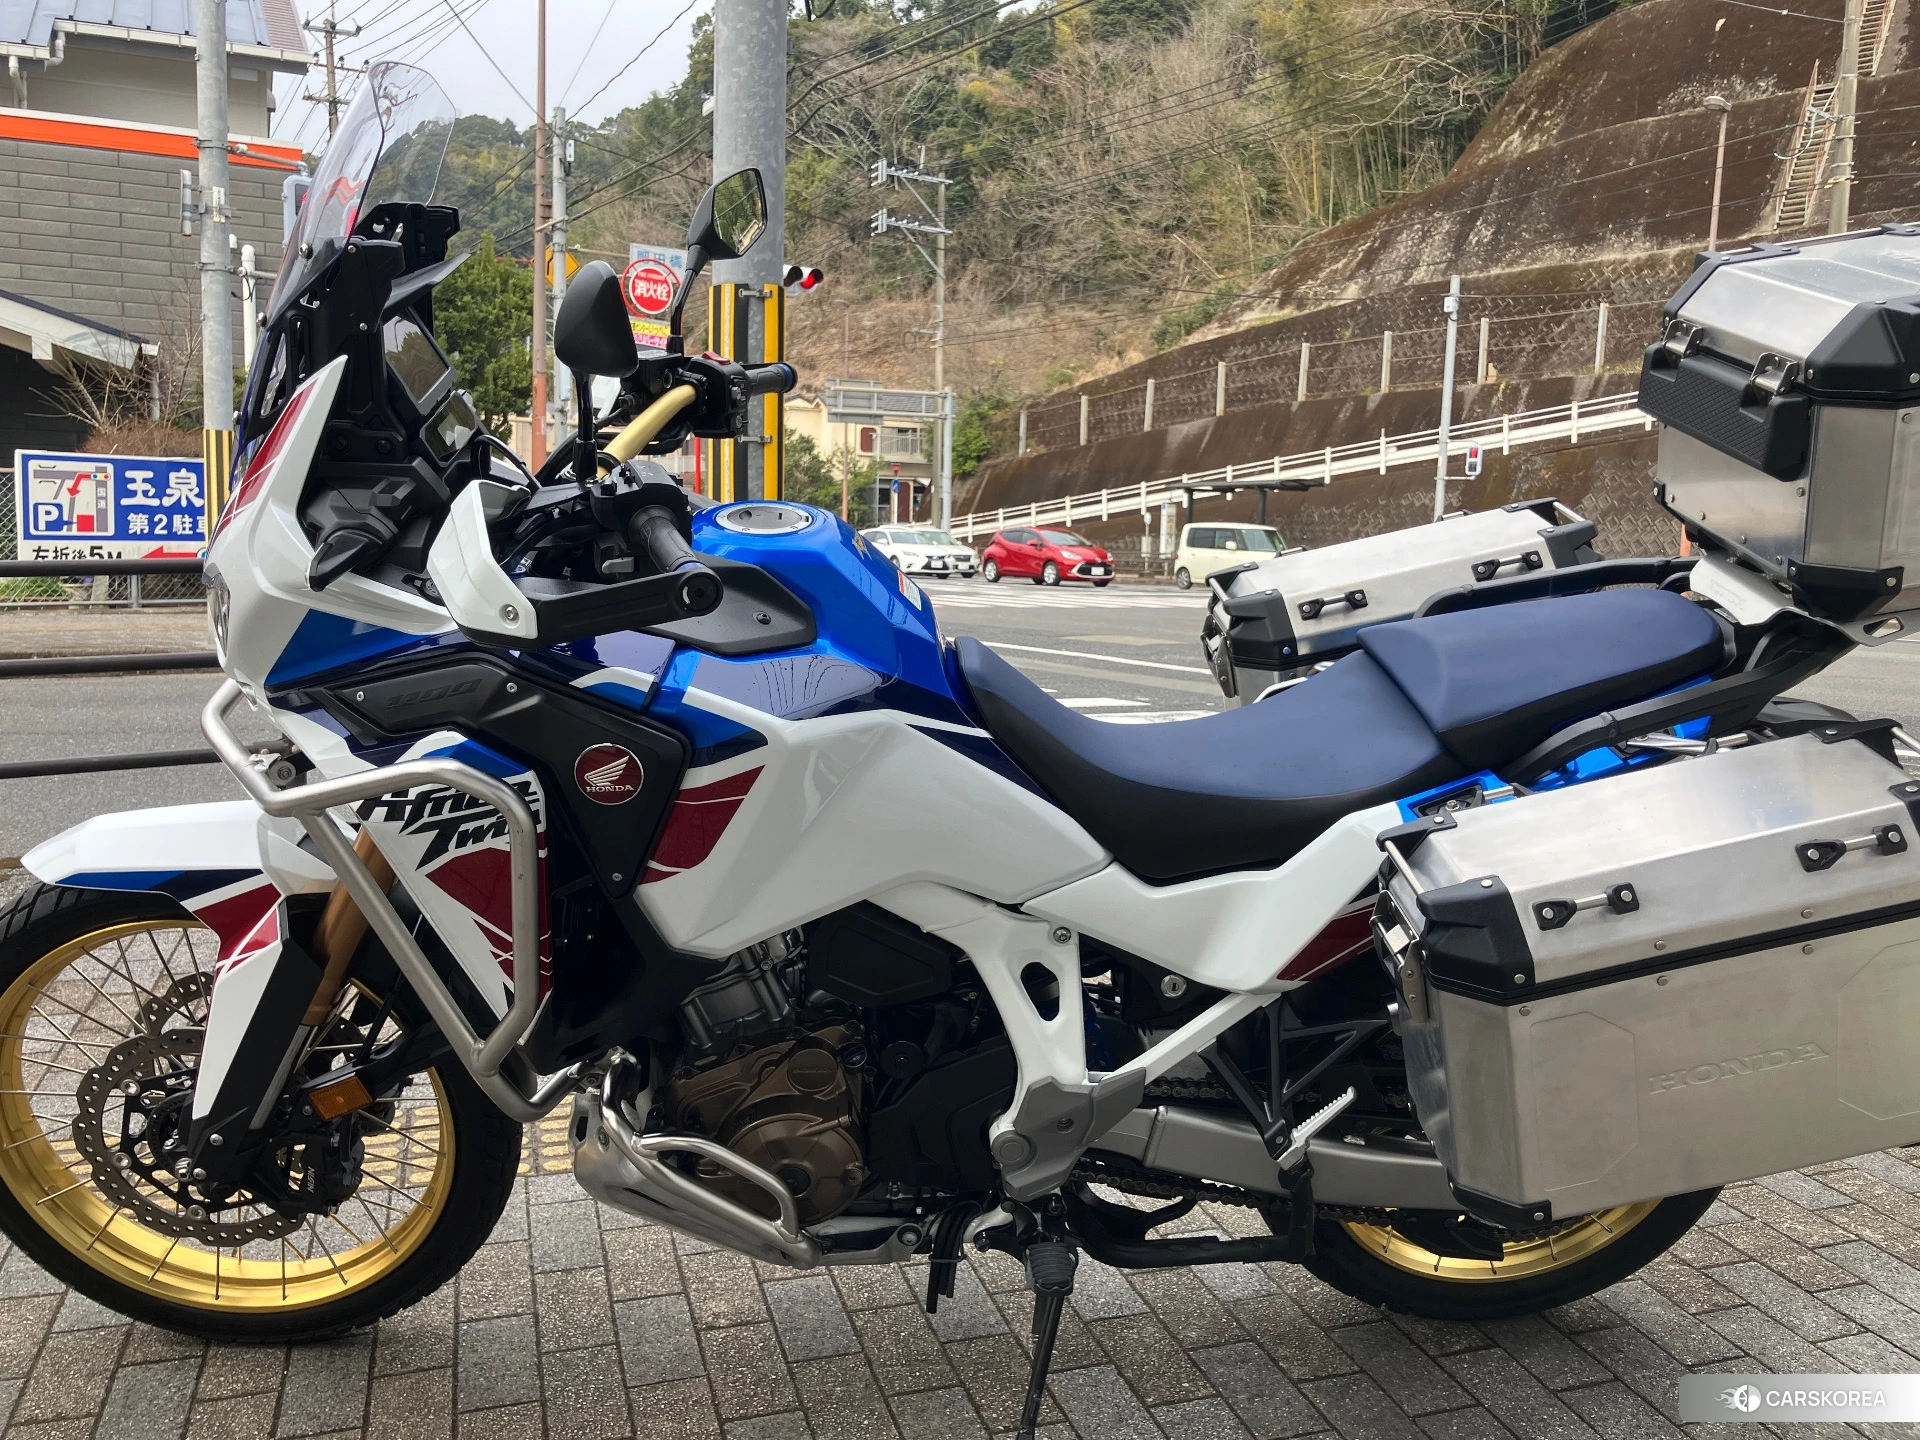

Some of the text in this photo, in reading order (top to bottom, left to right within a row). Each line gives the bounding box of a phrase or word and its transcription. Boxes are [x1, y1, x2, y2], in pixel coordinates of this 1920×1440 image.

[634, 279, 669, 301] 消火栓
[120, 468, 205, 507] 玉泉
[38, 505, 59, 531] P
[586, 785, 635, 793] HONDA
[1649, 1041, 1829, 1094] HONDA
